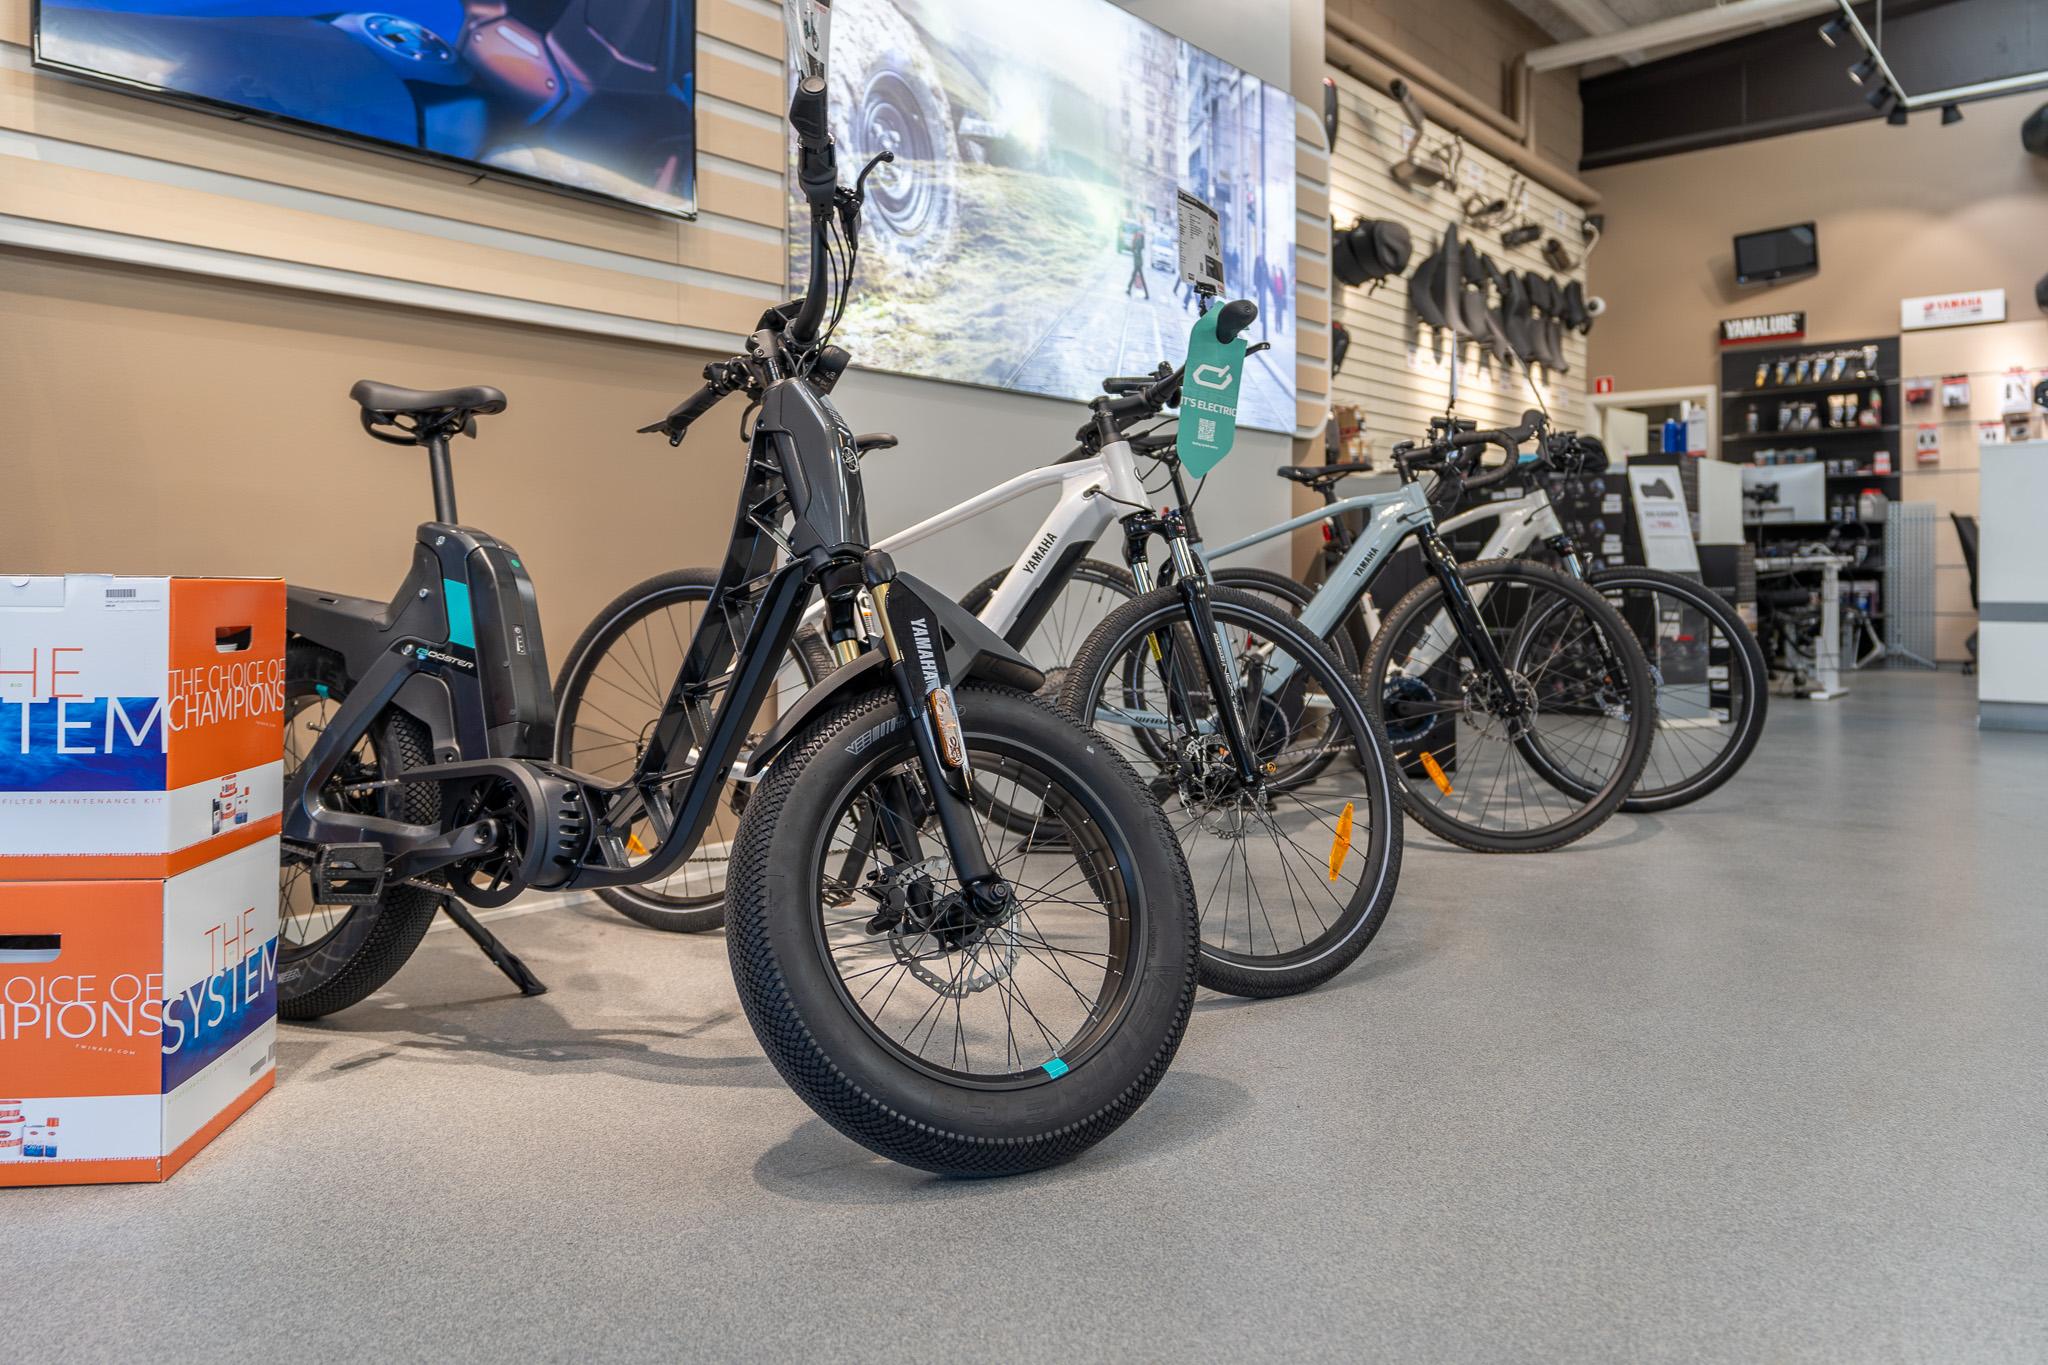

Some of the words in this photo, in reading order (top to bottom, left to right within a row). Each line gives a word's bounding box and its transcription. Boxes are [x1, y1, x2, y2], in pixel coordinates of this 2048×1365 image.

[1725, 313, 1798, 340] YAMALUBE
[1198, 400, 1238, 417] ELECTRIC
[1022, 531, 1058, 575] YAMAHA
[1353, 546, 1380, 577] YAMAHA
[0, 648, 83, 697] HE
[910, 617, 940, 686] YAMAHA
[168, 667, 204, 697] THE
[208, 660, 265, 694] CHOICE
[267, 658, 286, 685] OF
[0, 697, 168, 754] TEM
[168, 681, 286, 732] CHAMPIONS
[204, 907, 259, 978] THE
[4, 974, 97, 1006] OICE
[110, 973, 163, 1004] OF
[0, 1000, 163, 1041] PIONS
